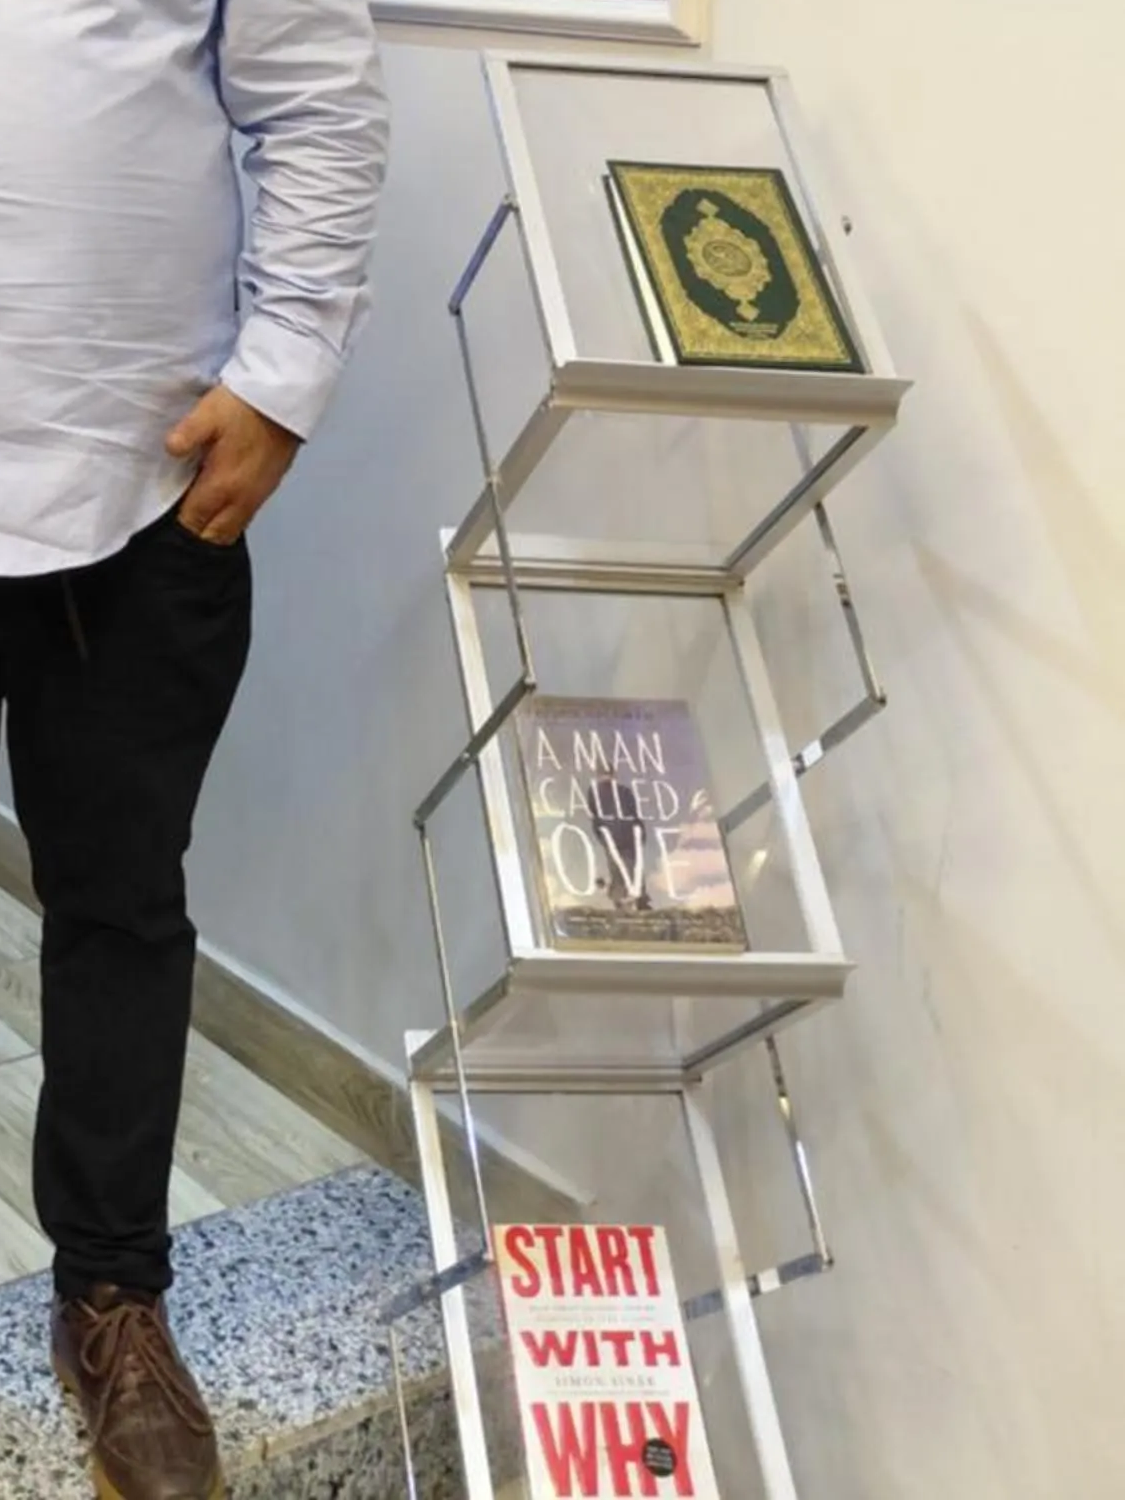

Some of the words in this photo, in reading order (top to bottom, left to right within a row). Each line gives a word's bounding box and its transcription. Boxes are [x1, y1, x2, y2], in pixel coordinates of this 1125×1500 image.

[537, 727, 562, 771] A
[574, 729, 666, 775] MAN
[539, 777, 680, 821] CALLED
[551, 820, 694, 901] OVE
[504, 1225, 661, 1297] START
[520, 1330, 681, 1367] WITH
[530, 1401, 695, 1498] WHY
